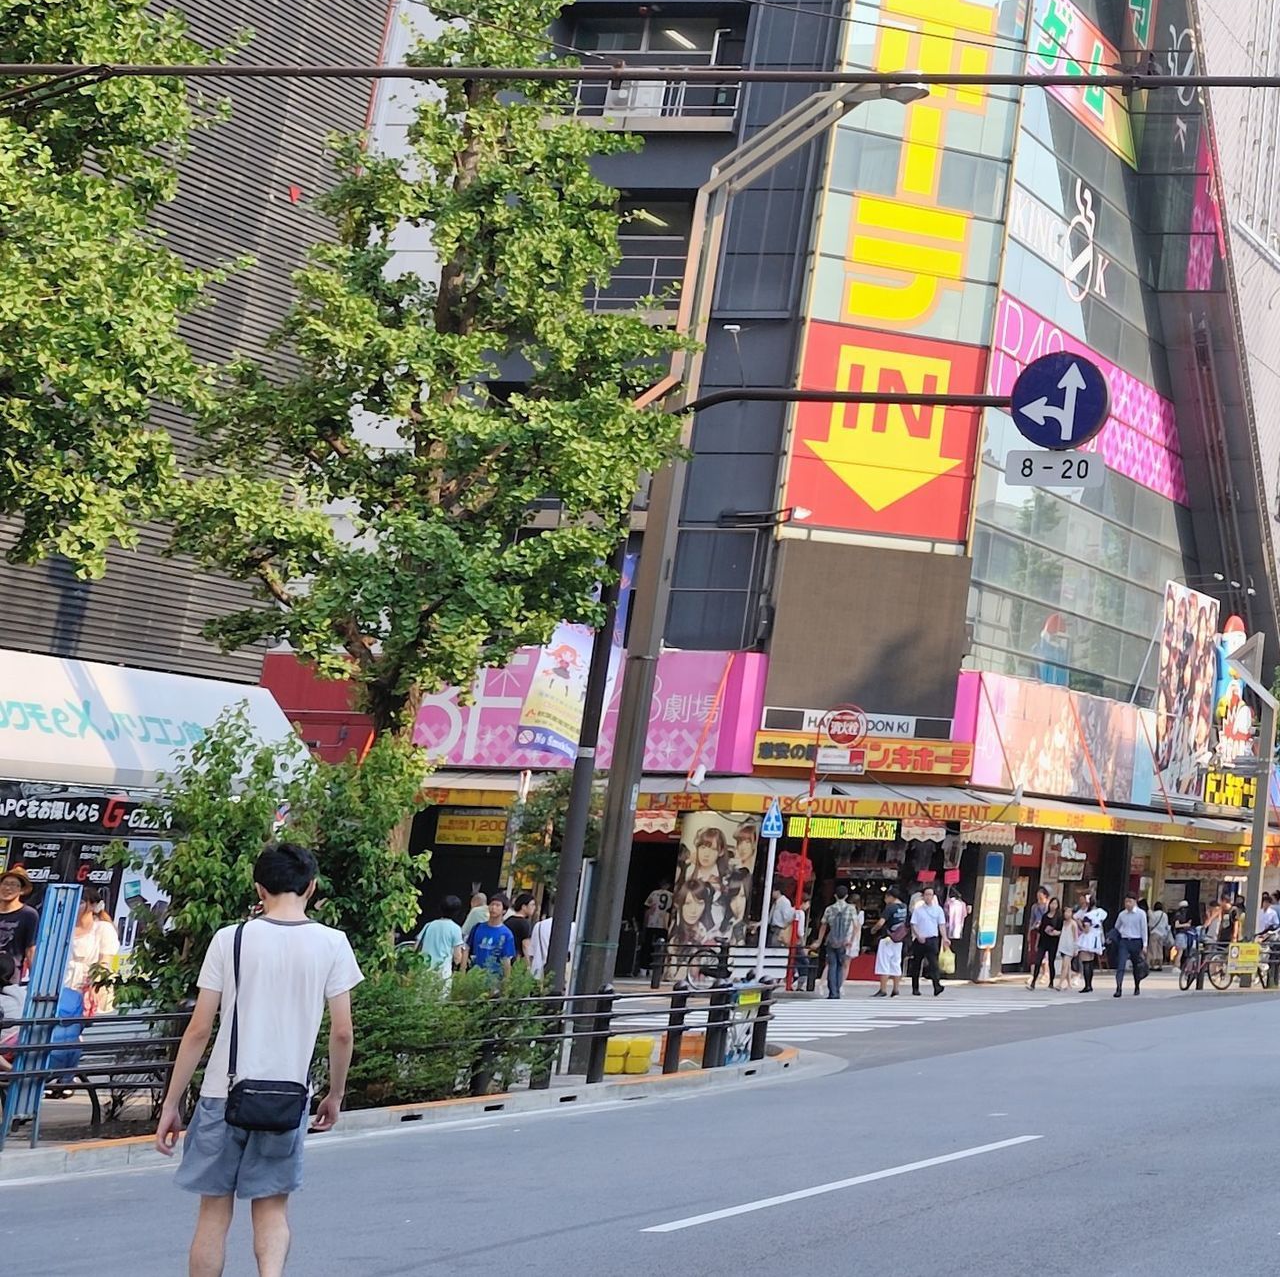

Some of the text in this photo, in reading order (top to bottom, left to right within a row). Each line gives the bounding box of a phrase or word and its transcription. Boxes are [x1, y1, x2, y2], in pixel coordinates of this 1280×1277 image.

[841, 363, 938, 441] IN
[1020, 458, 1089, 479] 8-20
[879, 801, 991, 820] AMUSEMENT
[658, 893, 669, 911] 9
